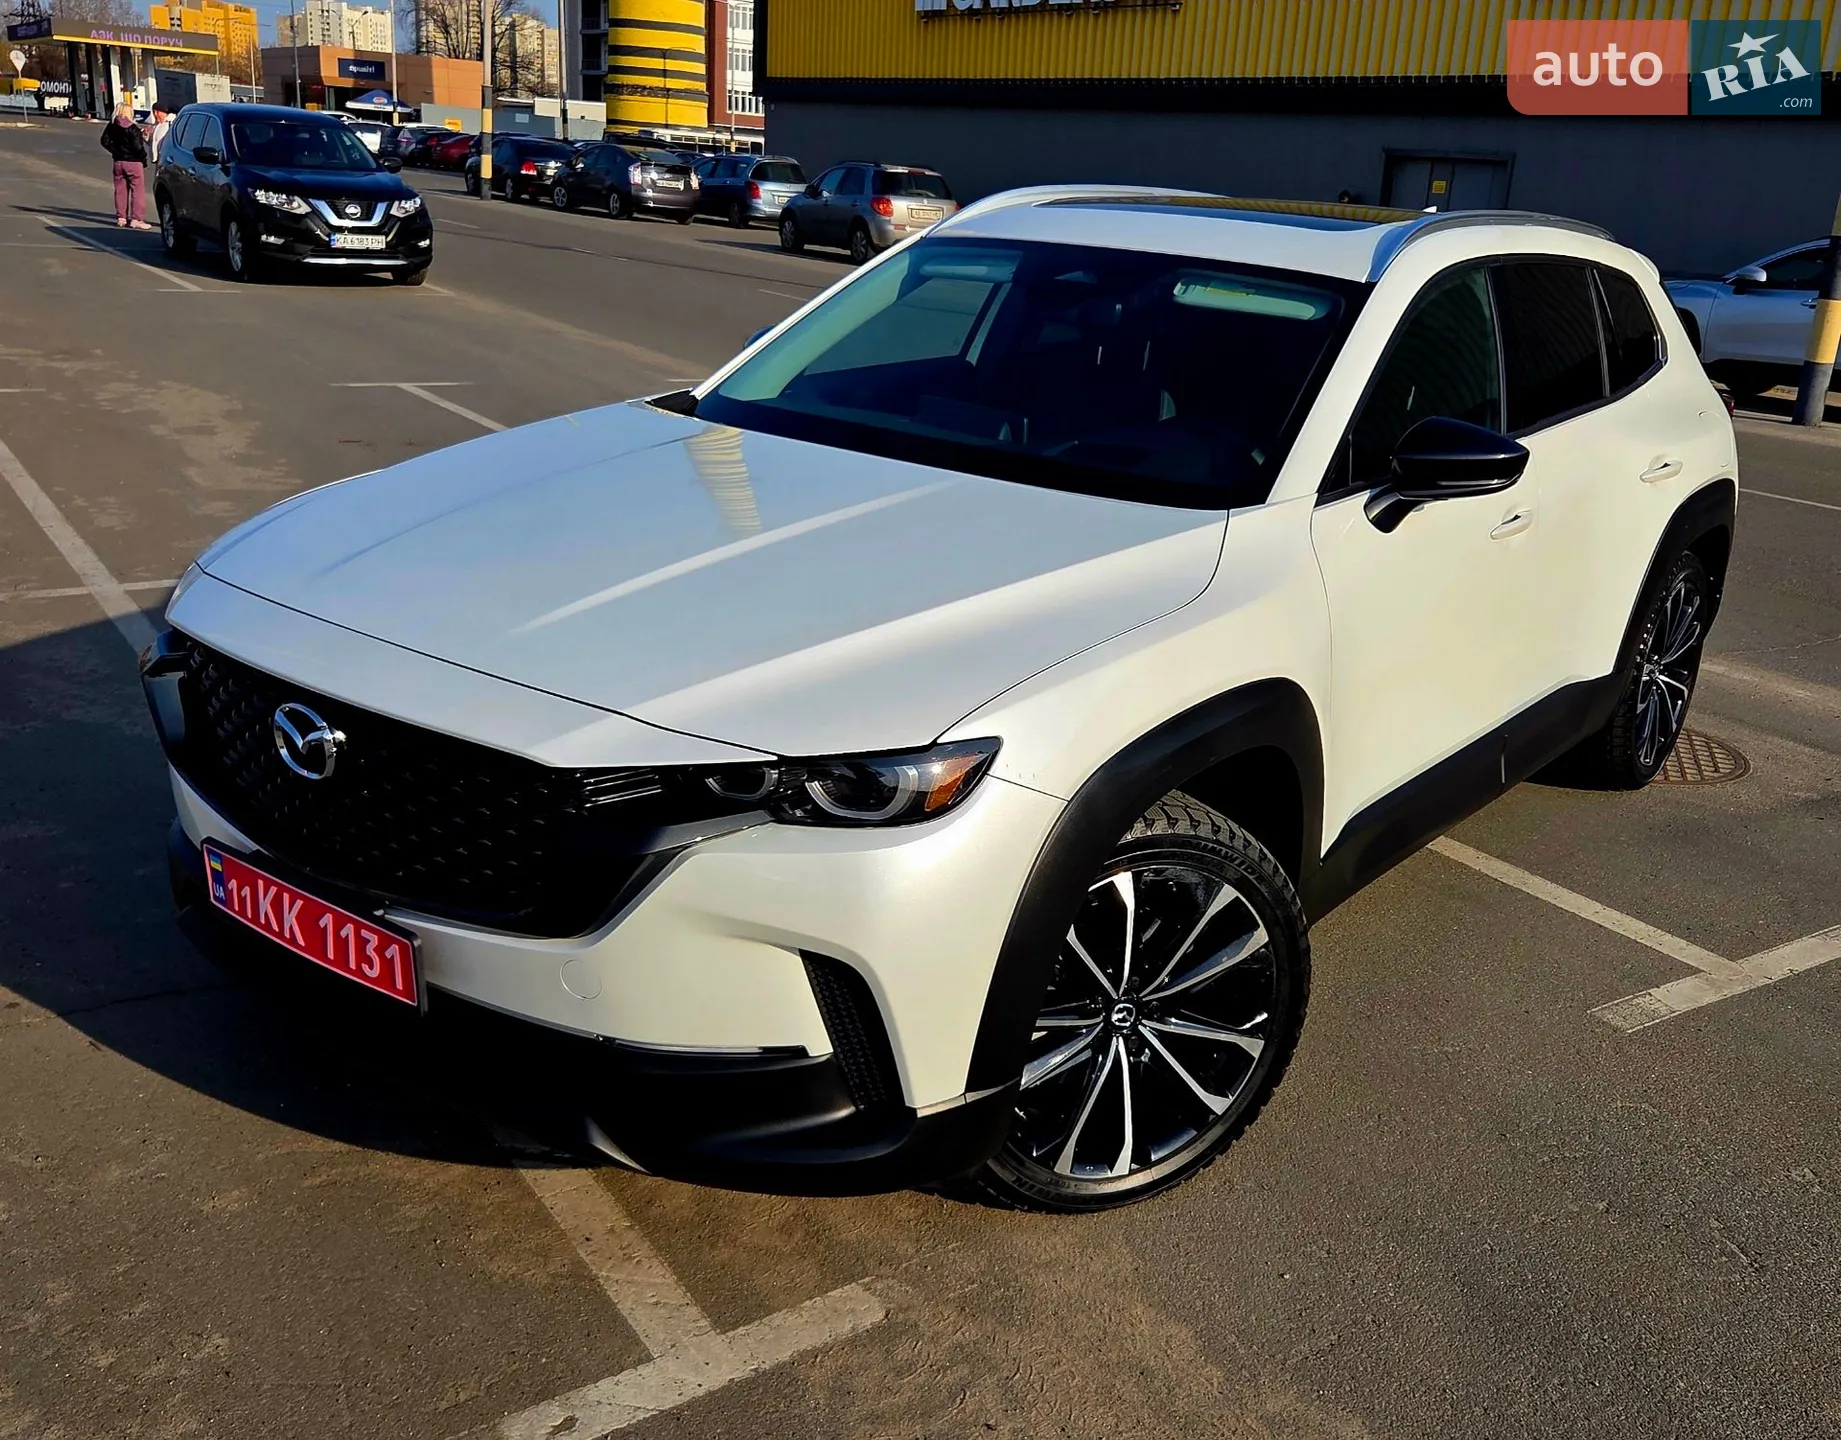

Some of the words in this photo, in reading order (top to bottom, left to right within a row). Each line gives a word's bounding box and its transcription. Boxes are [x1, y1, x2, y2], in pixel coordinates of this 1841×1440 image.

[213, 884, 225, 900] UA
[228, 878, 305, 947] 11KK
[318, 913, 403, 990] 1131
